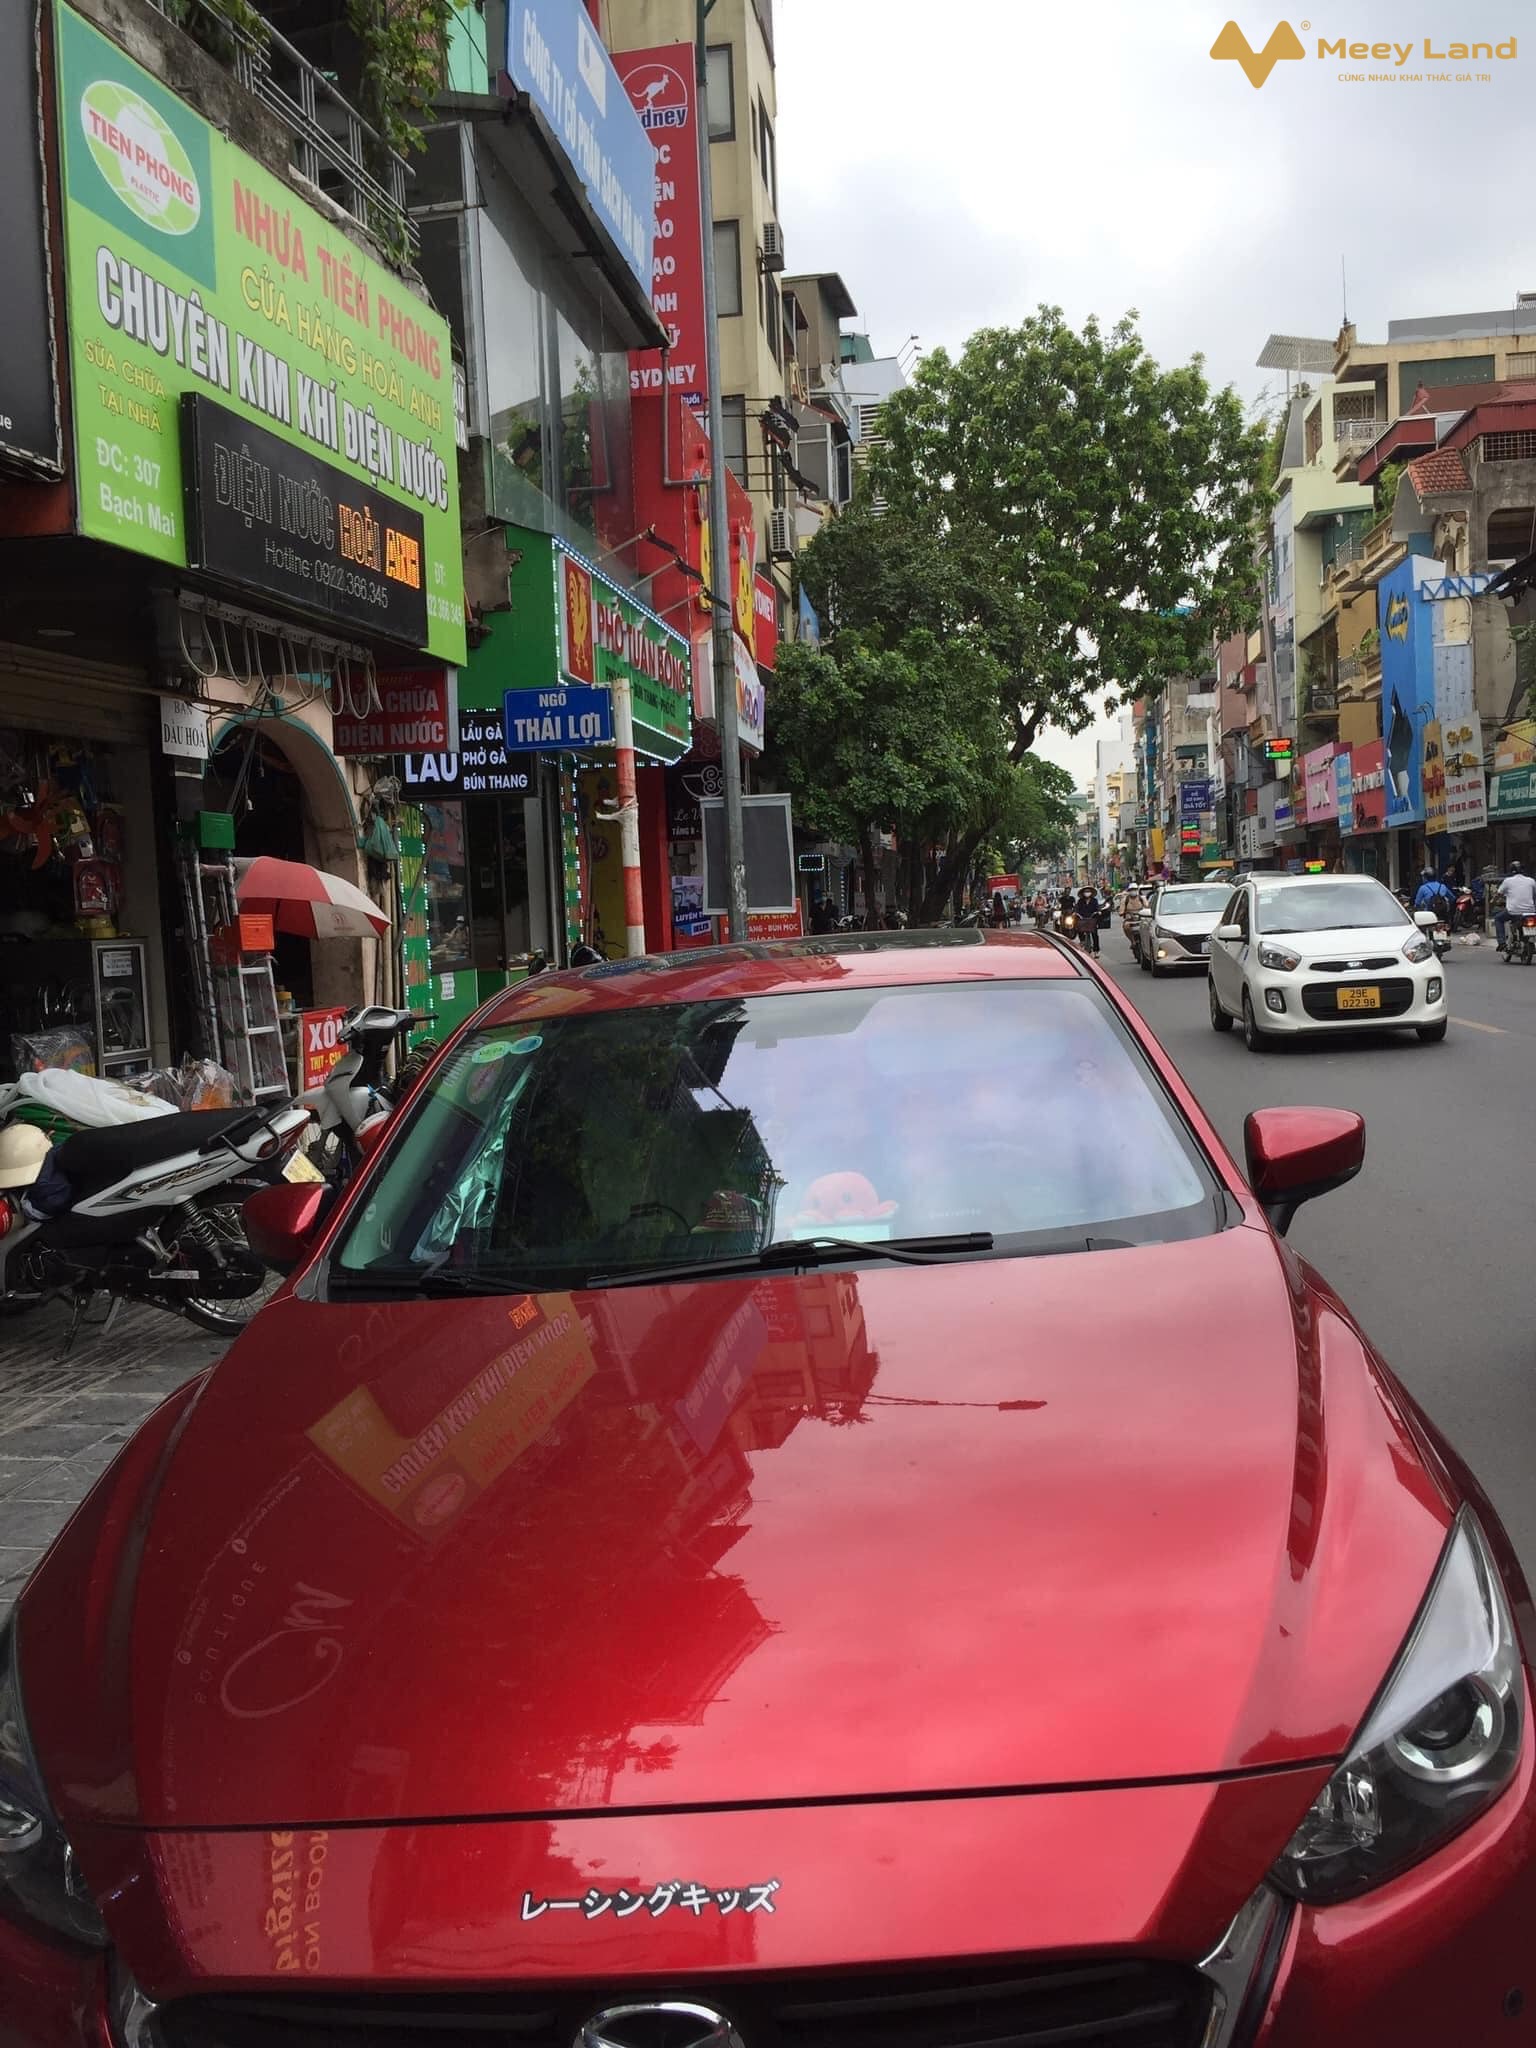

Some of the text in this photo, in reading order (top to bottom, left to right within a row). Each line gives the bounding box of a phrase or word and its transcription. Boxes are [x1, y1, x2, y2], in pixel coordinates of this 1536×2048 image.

[641, 108, 688, 129] dney
[88, 108, 195, 207] TIEN PHONG
[232, 177, 310, 286] NHỰA
[378, 294, 442, 381] PHONG
[240, 263, 293, 336] CỬA
[298, 296, 358, 378] HÀNG
[361, 353, 405, 410] HOÀI
[408, 386, 443, 434] ANH
[85, 338, 168, 402] SỬA CHỮA
[95, 244, 232, 394] CHUYÊN
[236, 332, 292, 426] KIM
[296, 370, 339, 453] KHÍ
[343, 399, 395, 487] ĐIỆN
[397, 436, 449, 511] NƯỚC
[629, 364, 697, 389] SYDNEY
[98, 384, 125, 420] TẠI
[95, 436, 162, 491] ĐC: 307
[100, 482, 176, 538] Bạch Mai
[212, 441, 274, 529] ĐIỆN
[277, 473, 336, 552] NƯỚC
[538, 690, 568, 707] NGÕ
[389, 716, 445, 745] NƯỚC
[485, 721, 504, 741] GÀ
[513, 709, 602, 745] THÁI LỢI
[462, 746, 508, 766] PHỞ GÀ
[463, 771, 529, 790] BÚN THANG
[520, 1880, 781, 1925] レーシングキッズ
